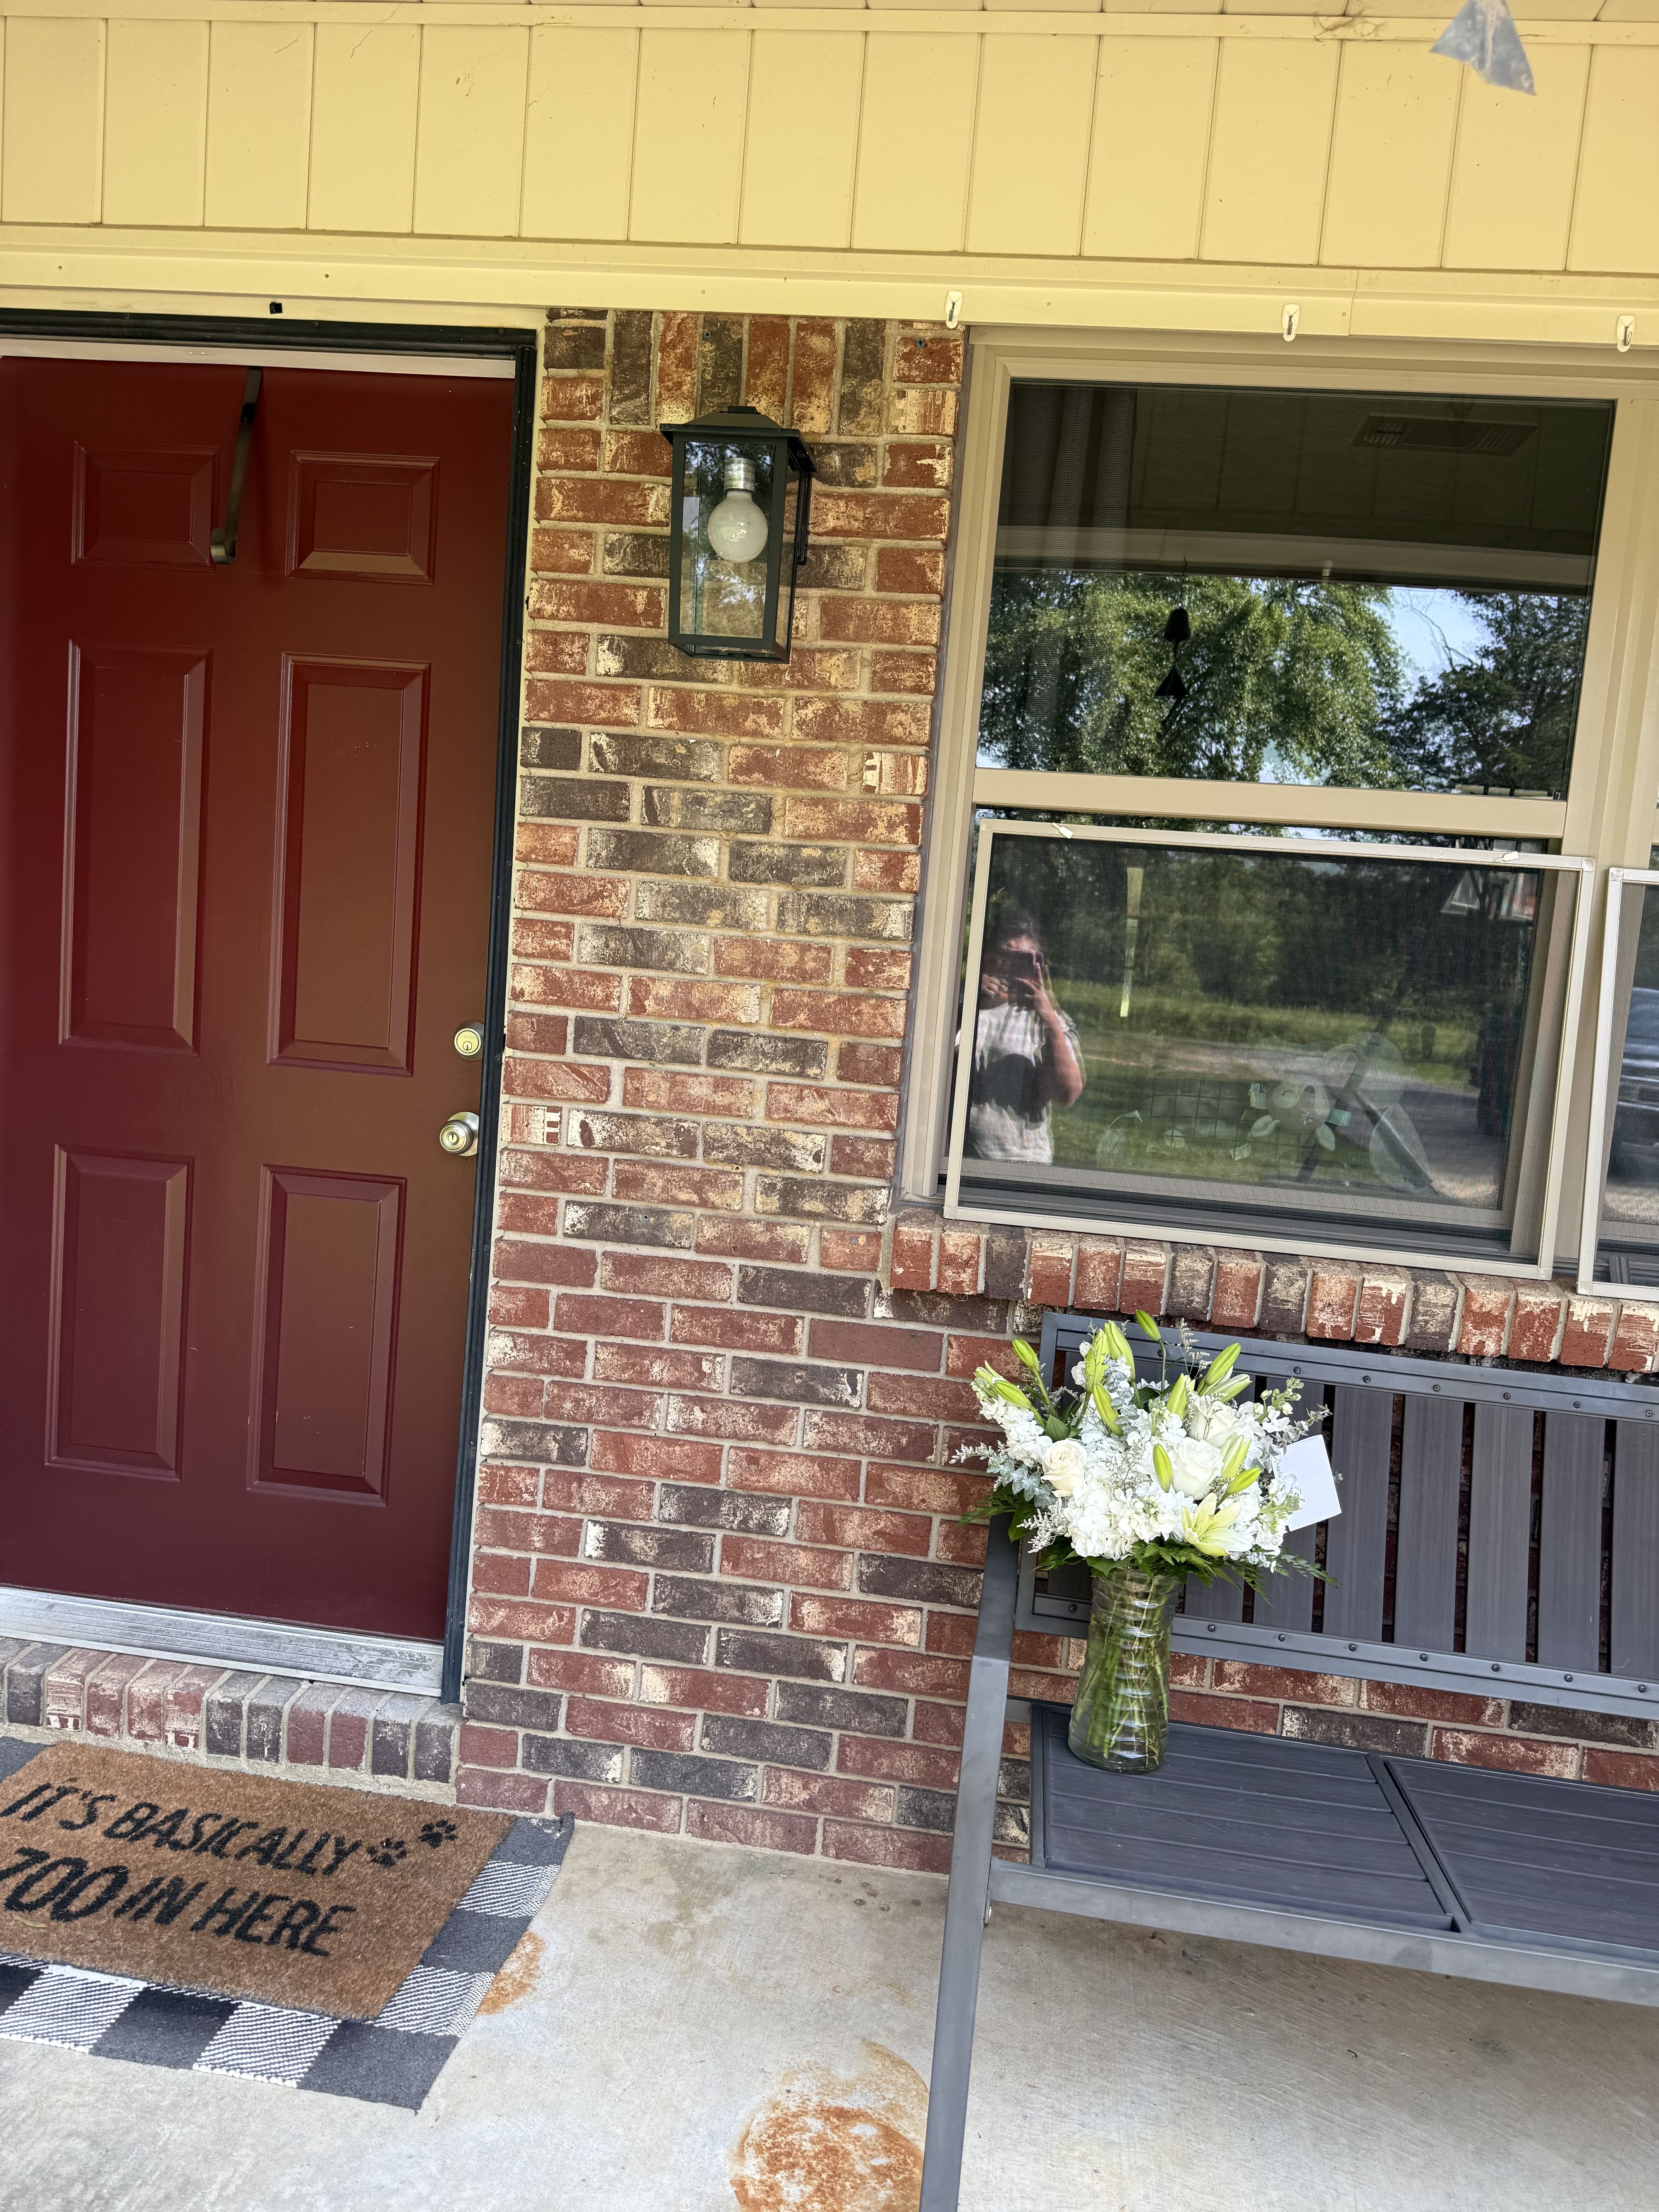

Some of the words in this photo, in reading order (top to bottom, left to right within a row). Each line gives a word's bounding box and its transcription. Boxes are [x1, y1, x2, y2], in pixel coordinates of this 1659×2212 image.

[0, 1783, 117, 1831] IT'S
[103, 1802, 362, 1876] BASICALLY
[113, 1876, 208, 1926] IN
[189, 1886, 358, 1956] HERE
